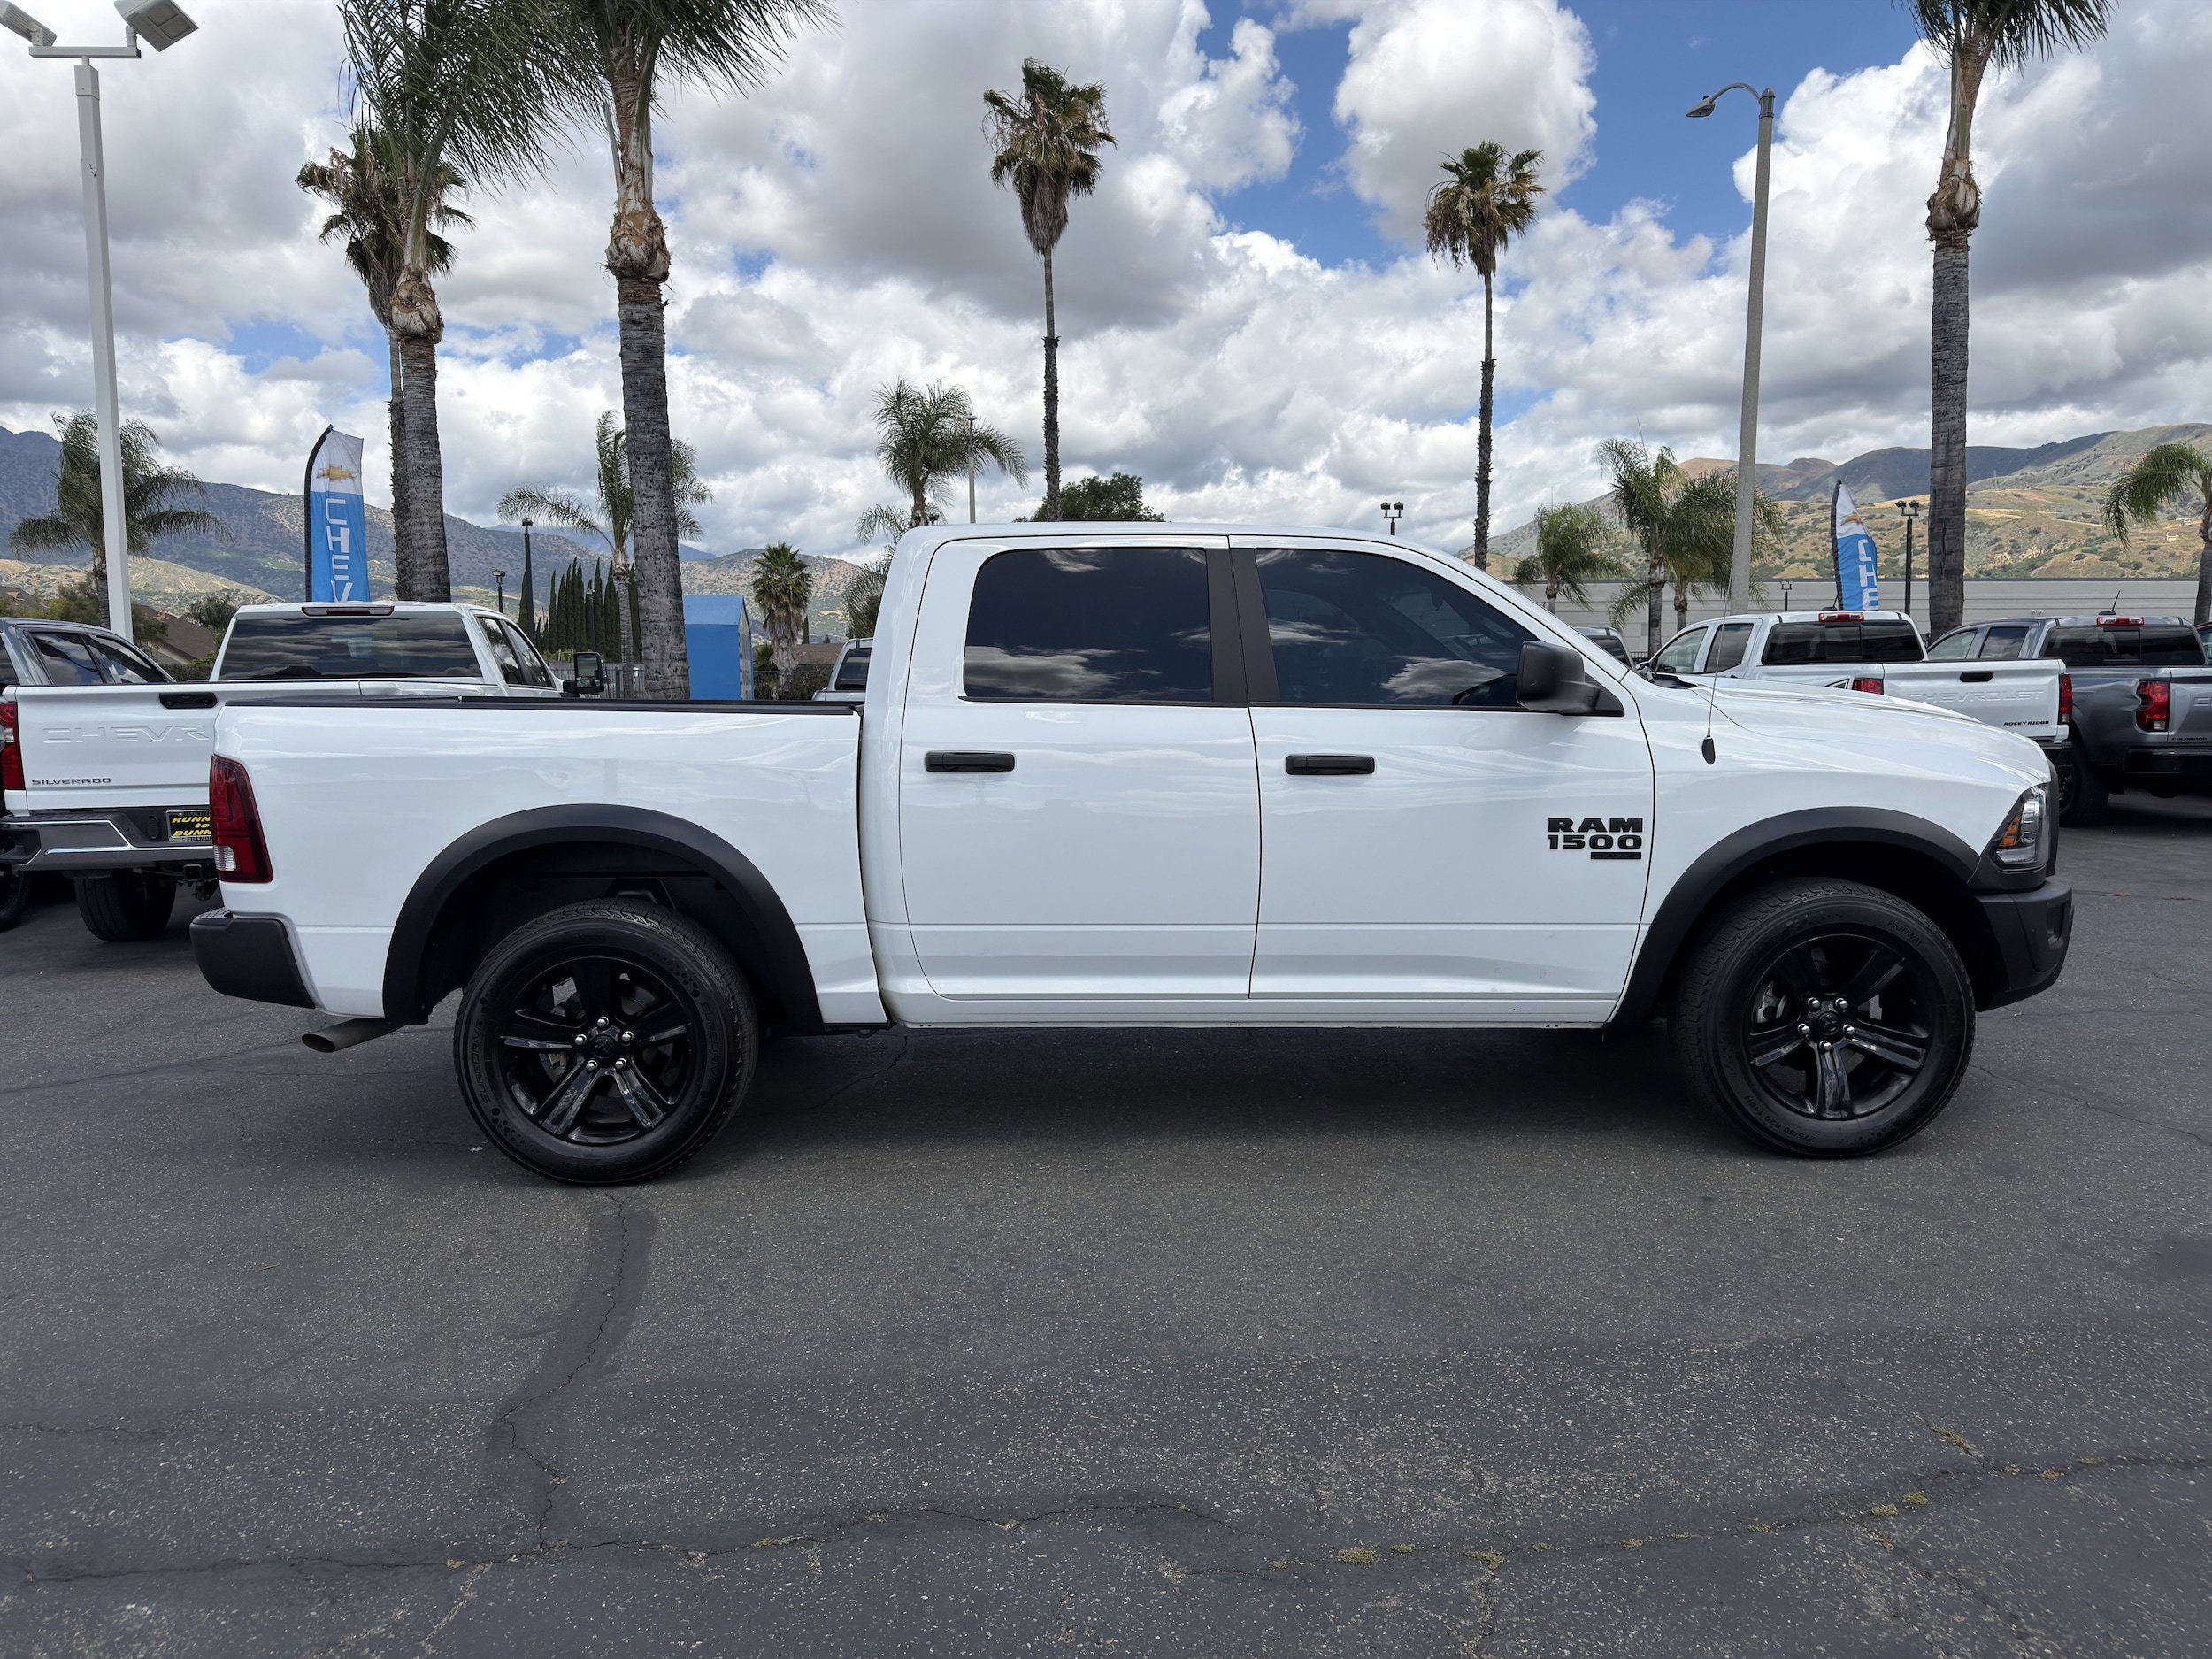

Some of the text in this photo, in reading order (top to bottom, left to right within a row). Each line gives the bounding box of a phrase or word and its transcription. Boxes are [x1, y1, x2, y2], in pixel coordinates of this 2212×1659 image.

[326, 498, 353, 603] CHEV
[32, 777, 111, 786] SILVERADO
[1548, 818, 1642, 833] RAM
[1548, 834, 1642, 849] 1500
